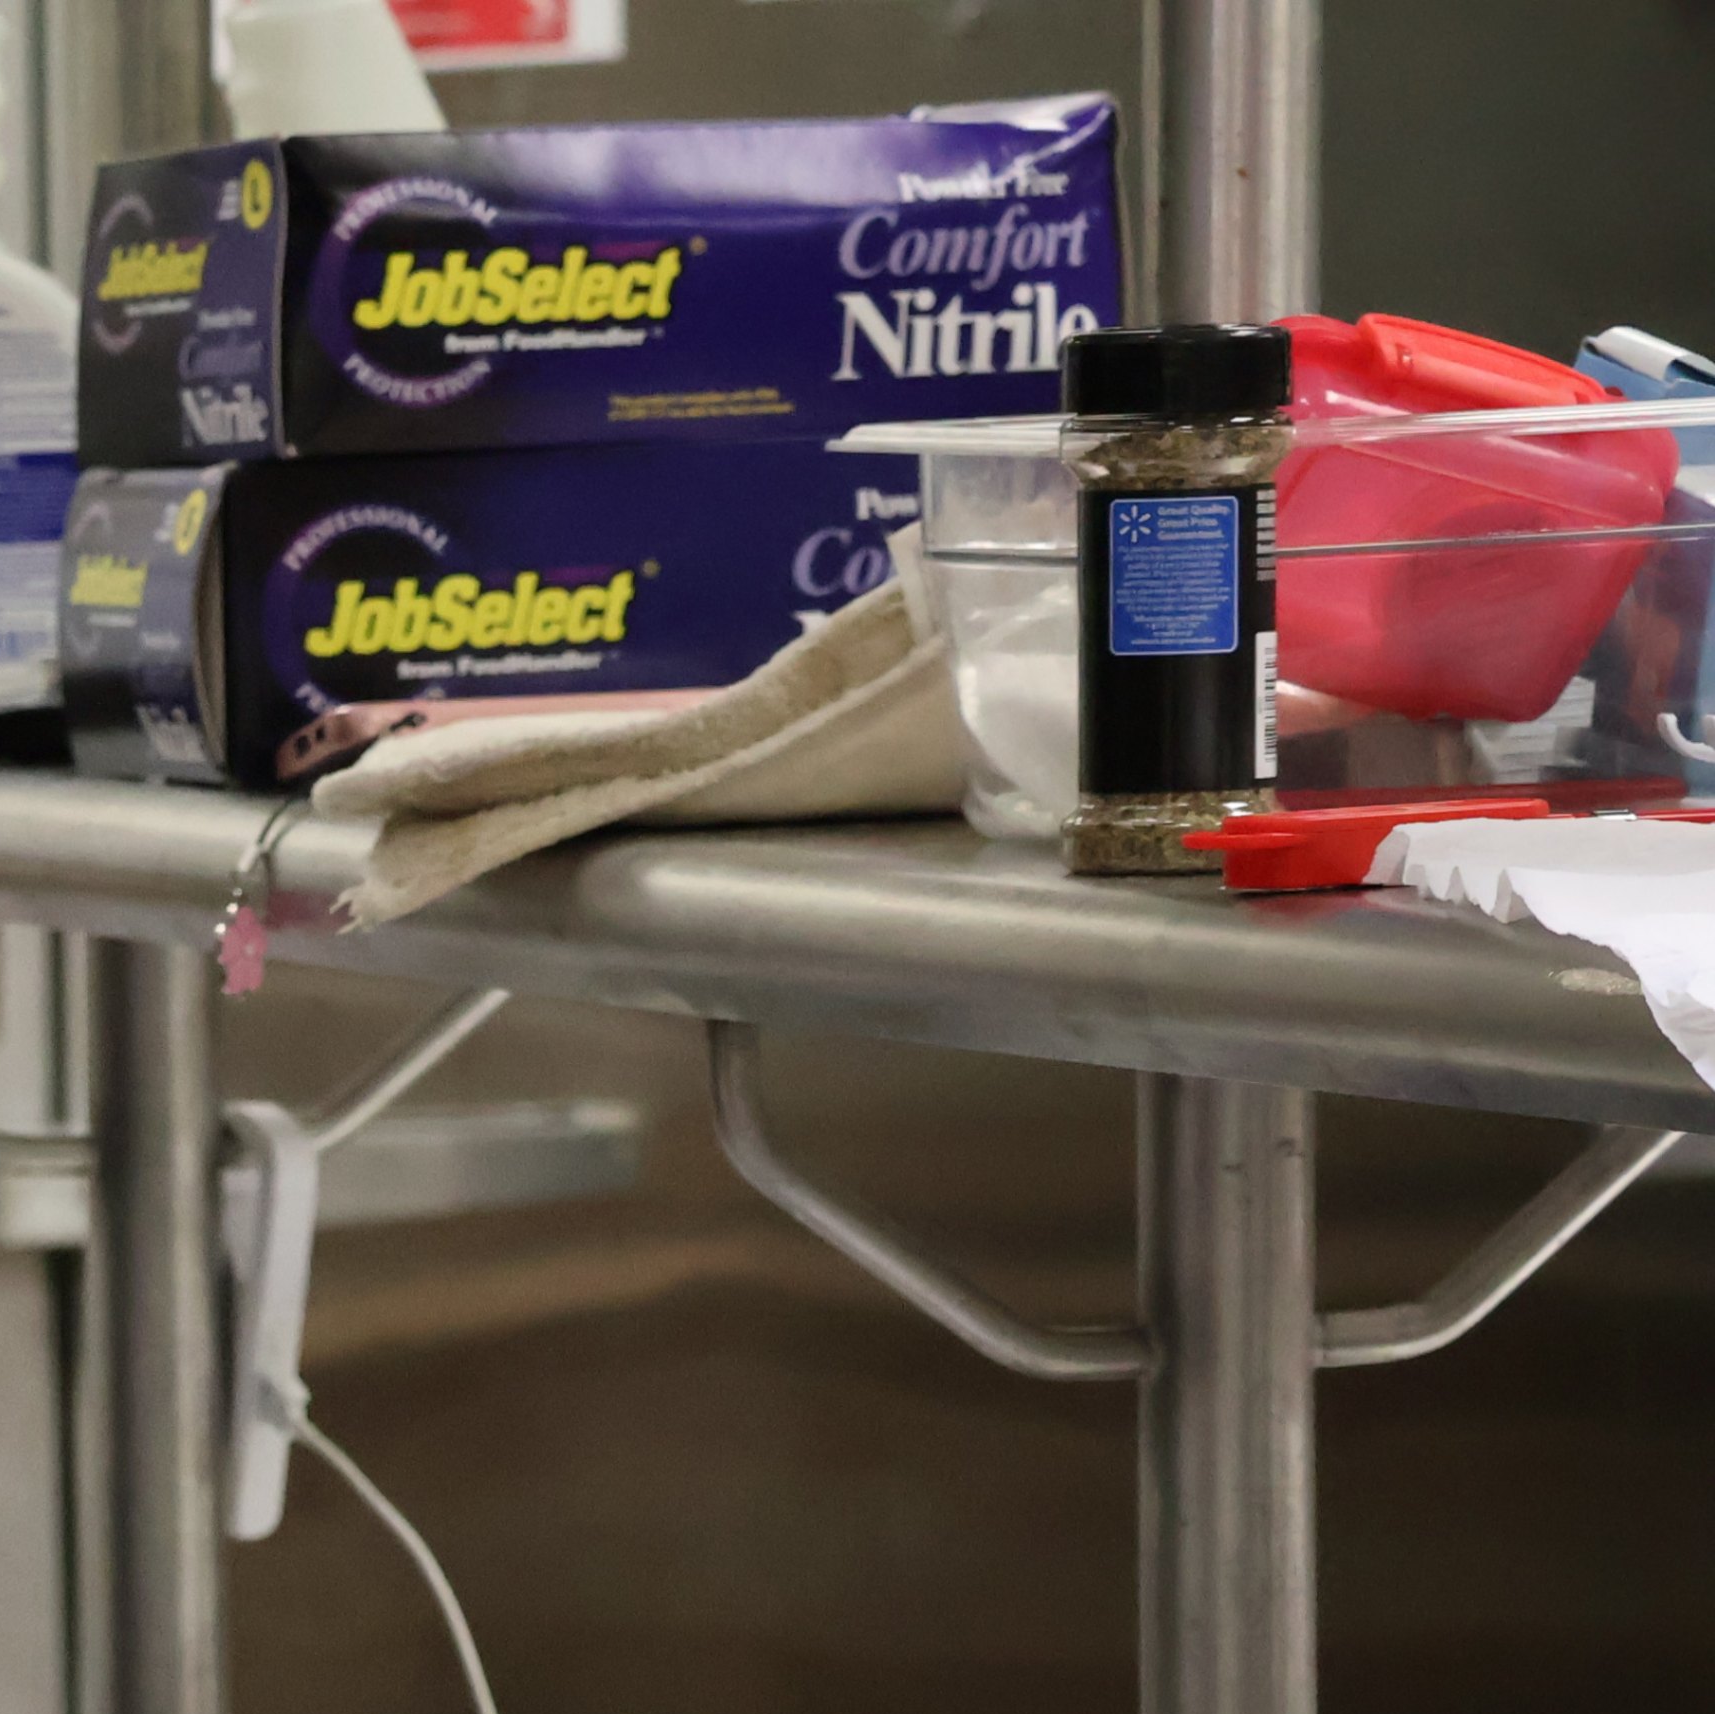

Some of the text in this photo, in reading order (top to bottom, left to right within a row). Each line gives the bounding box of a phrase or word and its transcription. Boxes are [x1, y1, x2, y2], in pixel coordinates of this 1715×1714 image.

[353, 245, 682, 330] JobSelect
[838, 202, 1089, 291] Comfort
[304, 570, 636, 658] JobSelect
